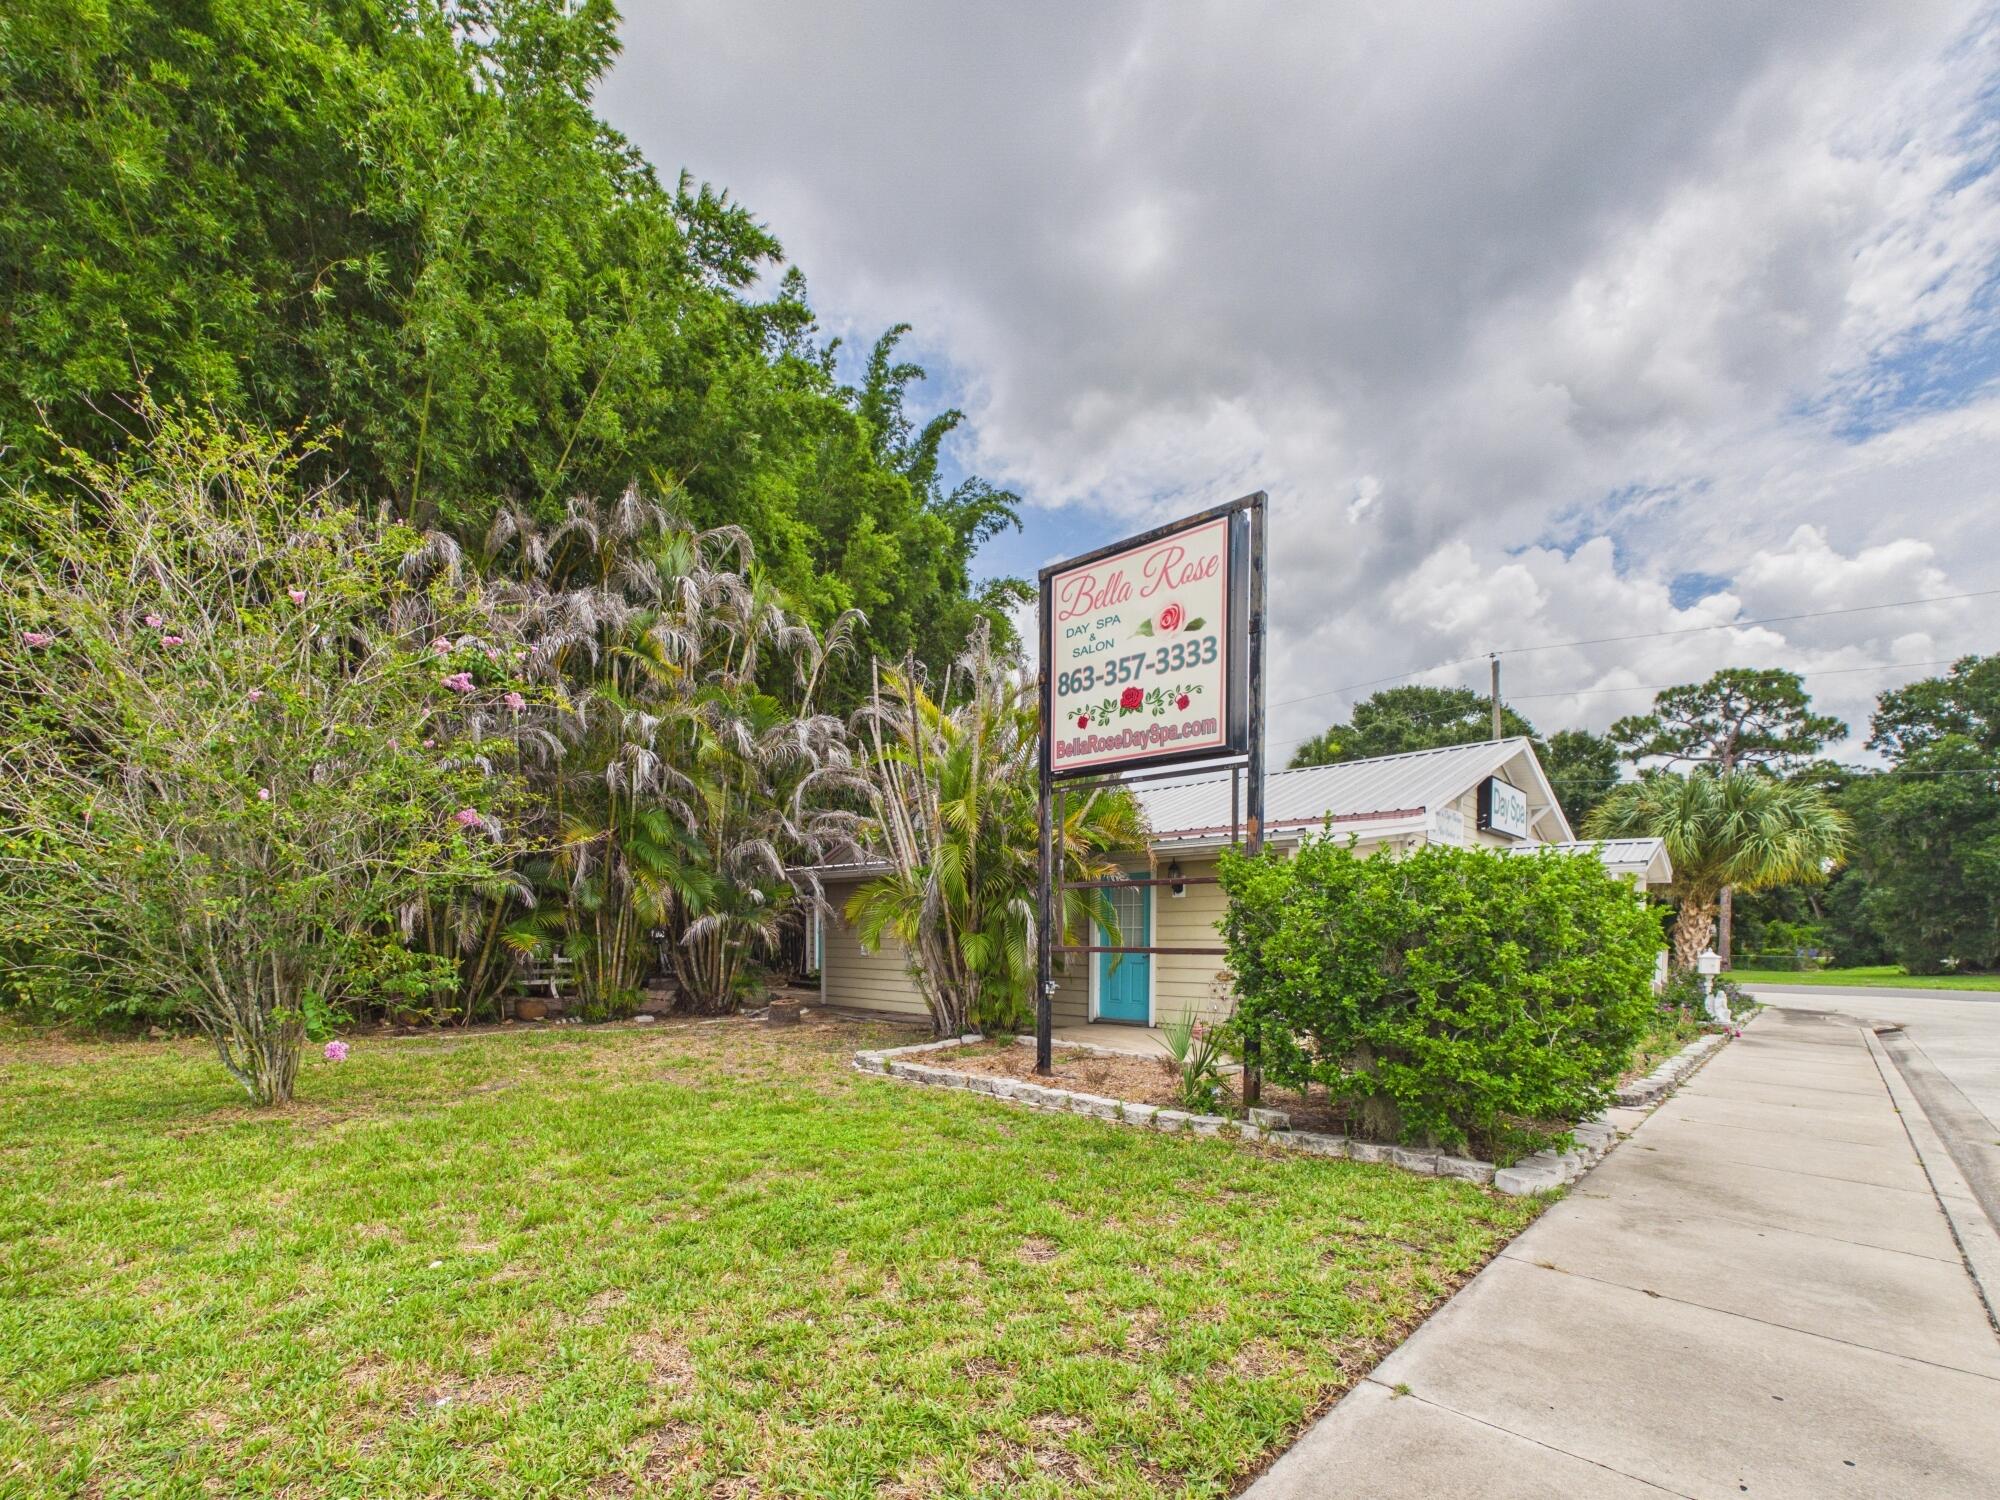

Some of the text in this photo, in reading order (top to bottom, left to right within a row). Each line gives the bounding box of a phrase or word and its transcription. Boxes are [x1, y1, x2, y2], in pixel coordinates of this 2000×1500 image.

[1059, 546, 1219, 621] Bella Rose
[1066, 614, 1121, 639] DAY SPA
[1089, 633, 1096, 642] &
[1057, 635, 1218, 697] 863-357-3333
[1072, 638, 1115, 658] SALON
[1056, 717, 1217, 759] BellaRoseDaySpa.com
[1493, 786, 1525, 829] Day Spa
